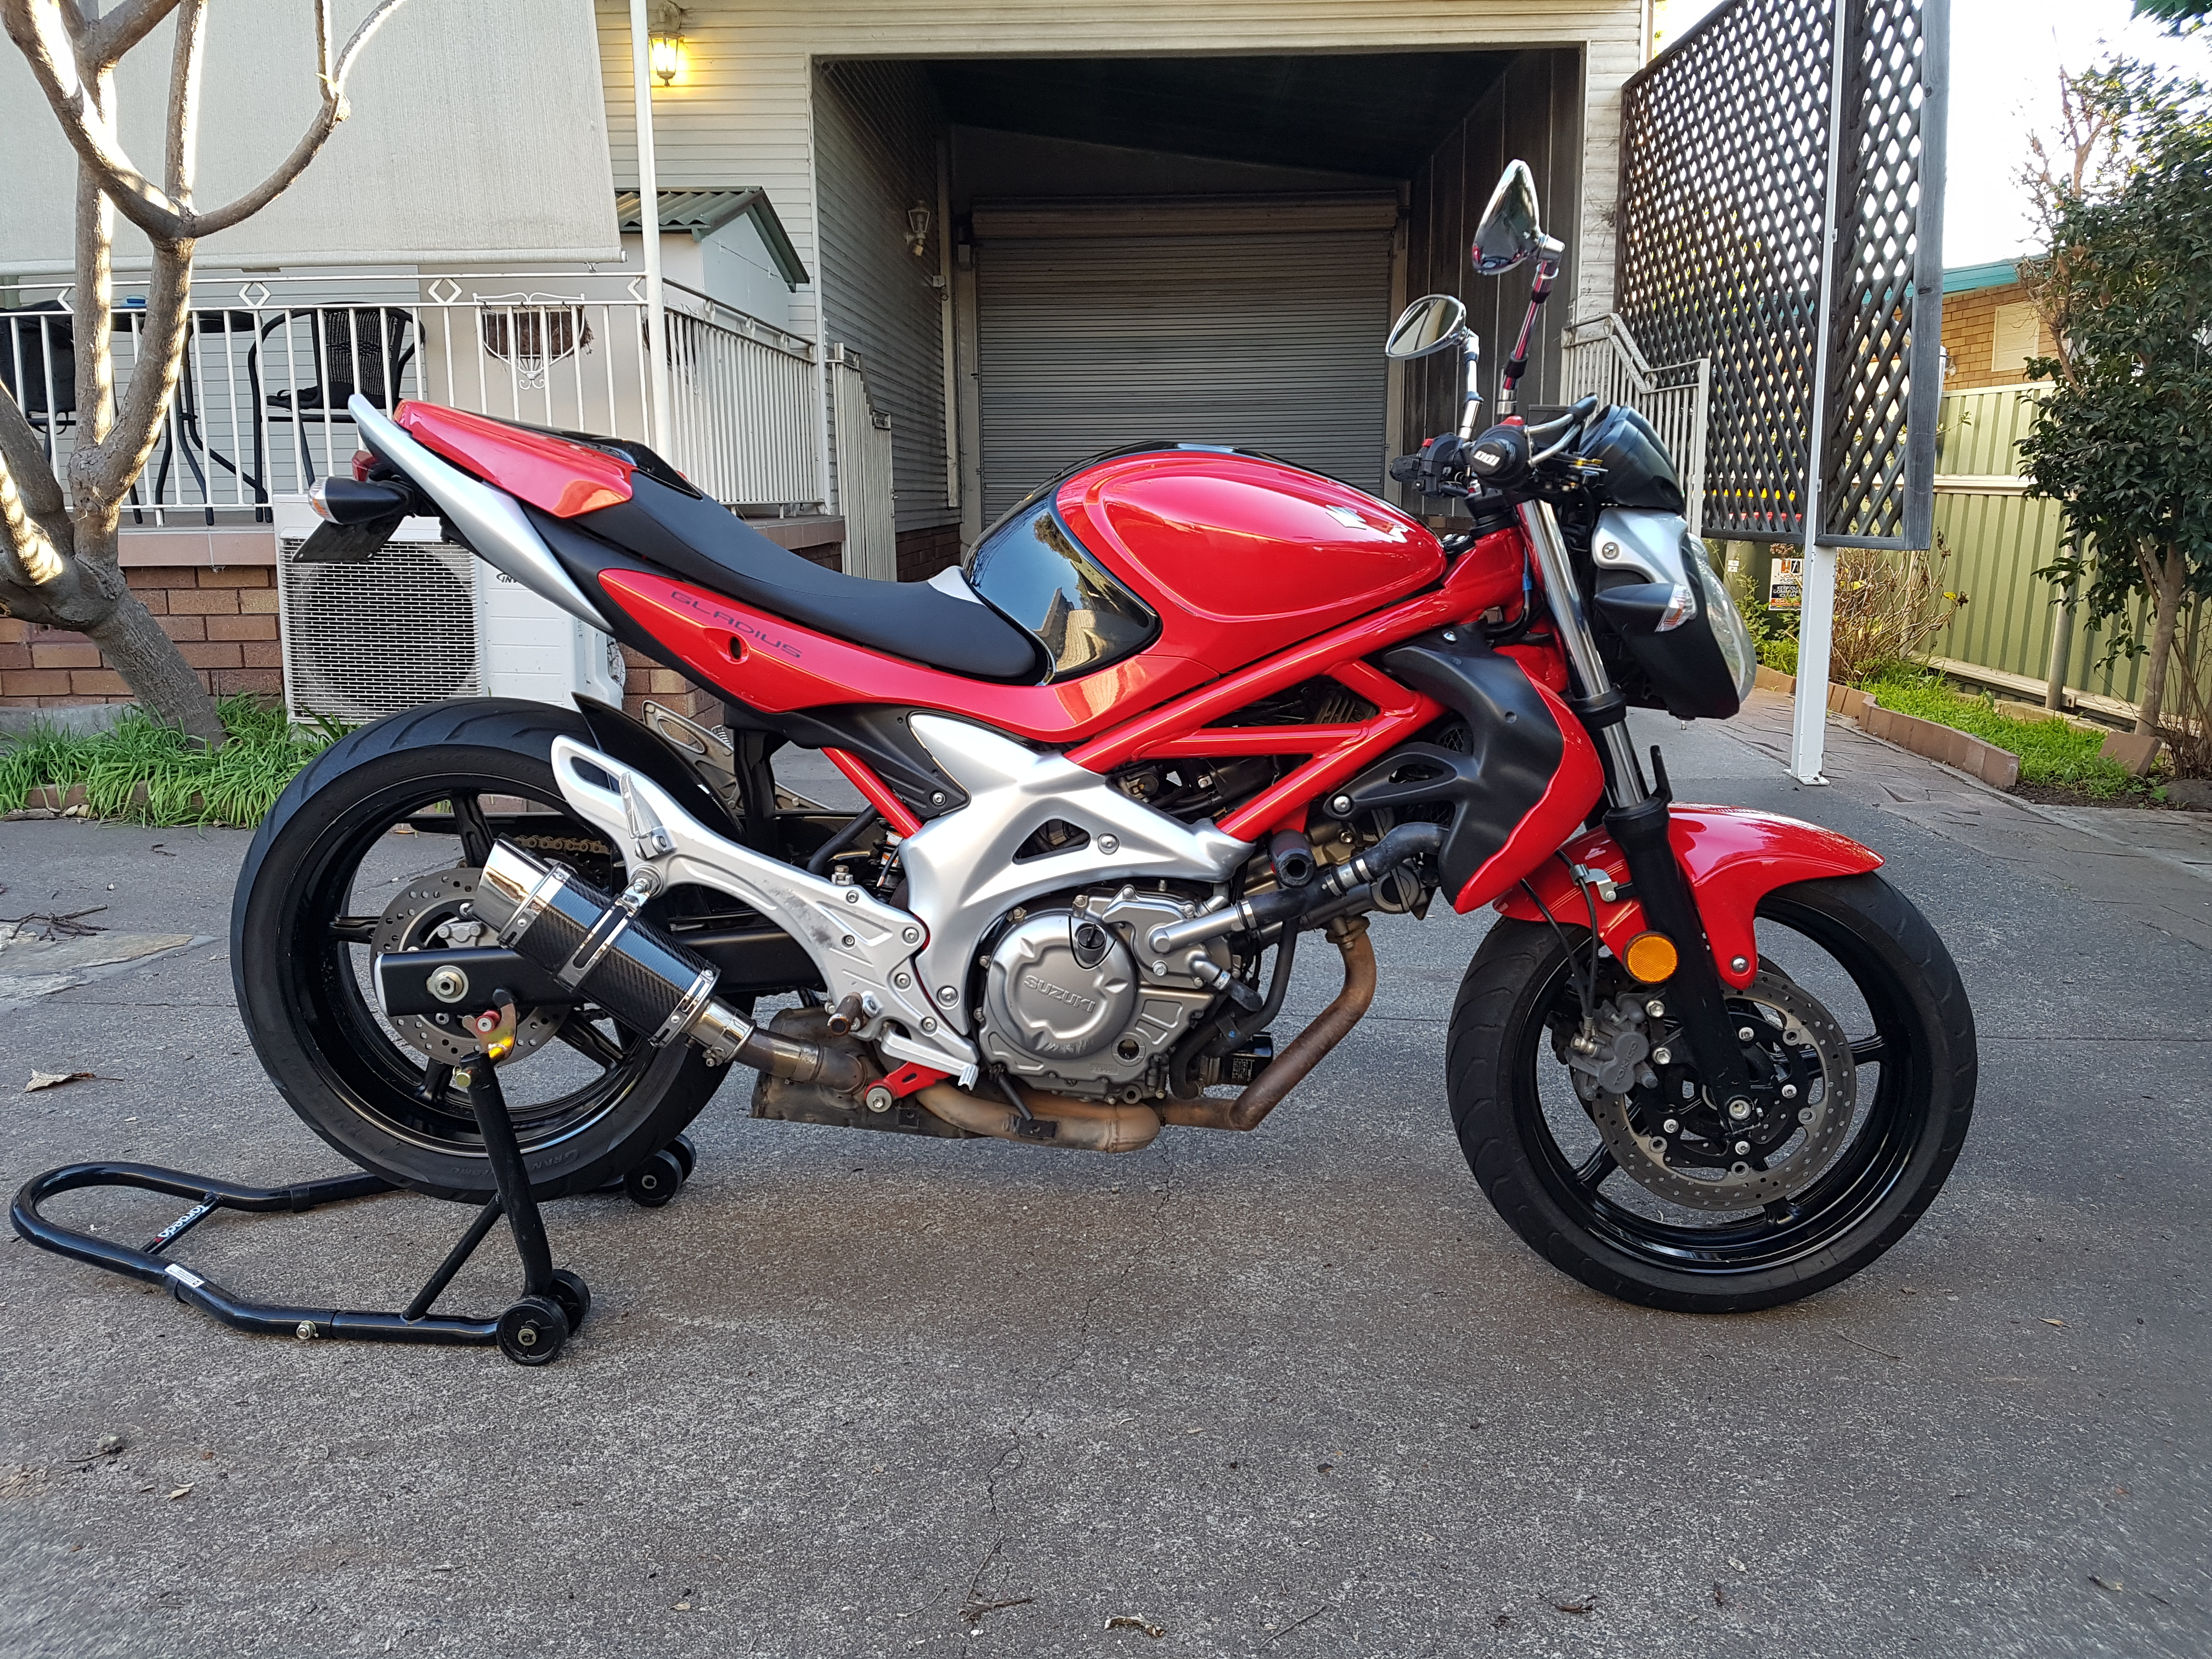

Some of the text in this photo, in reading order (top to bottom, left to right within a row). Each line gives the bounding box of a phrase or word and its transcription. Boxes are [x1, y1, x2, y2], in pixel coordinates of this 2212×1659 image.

[671, 591, 802, 658] GLADIUS
[1024, 975, 1096, 1013] SUZUKI
[1614, 1041, 1638, 1086] TOKICO
[532, 1149, 579, 1170] GRAN
[157, 1205, 209, 1237] Torpedo
